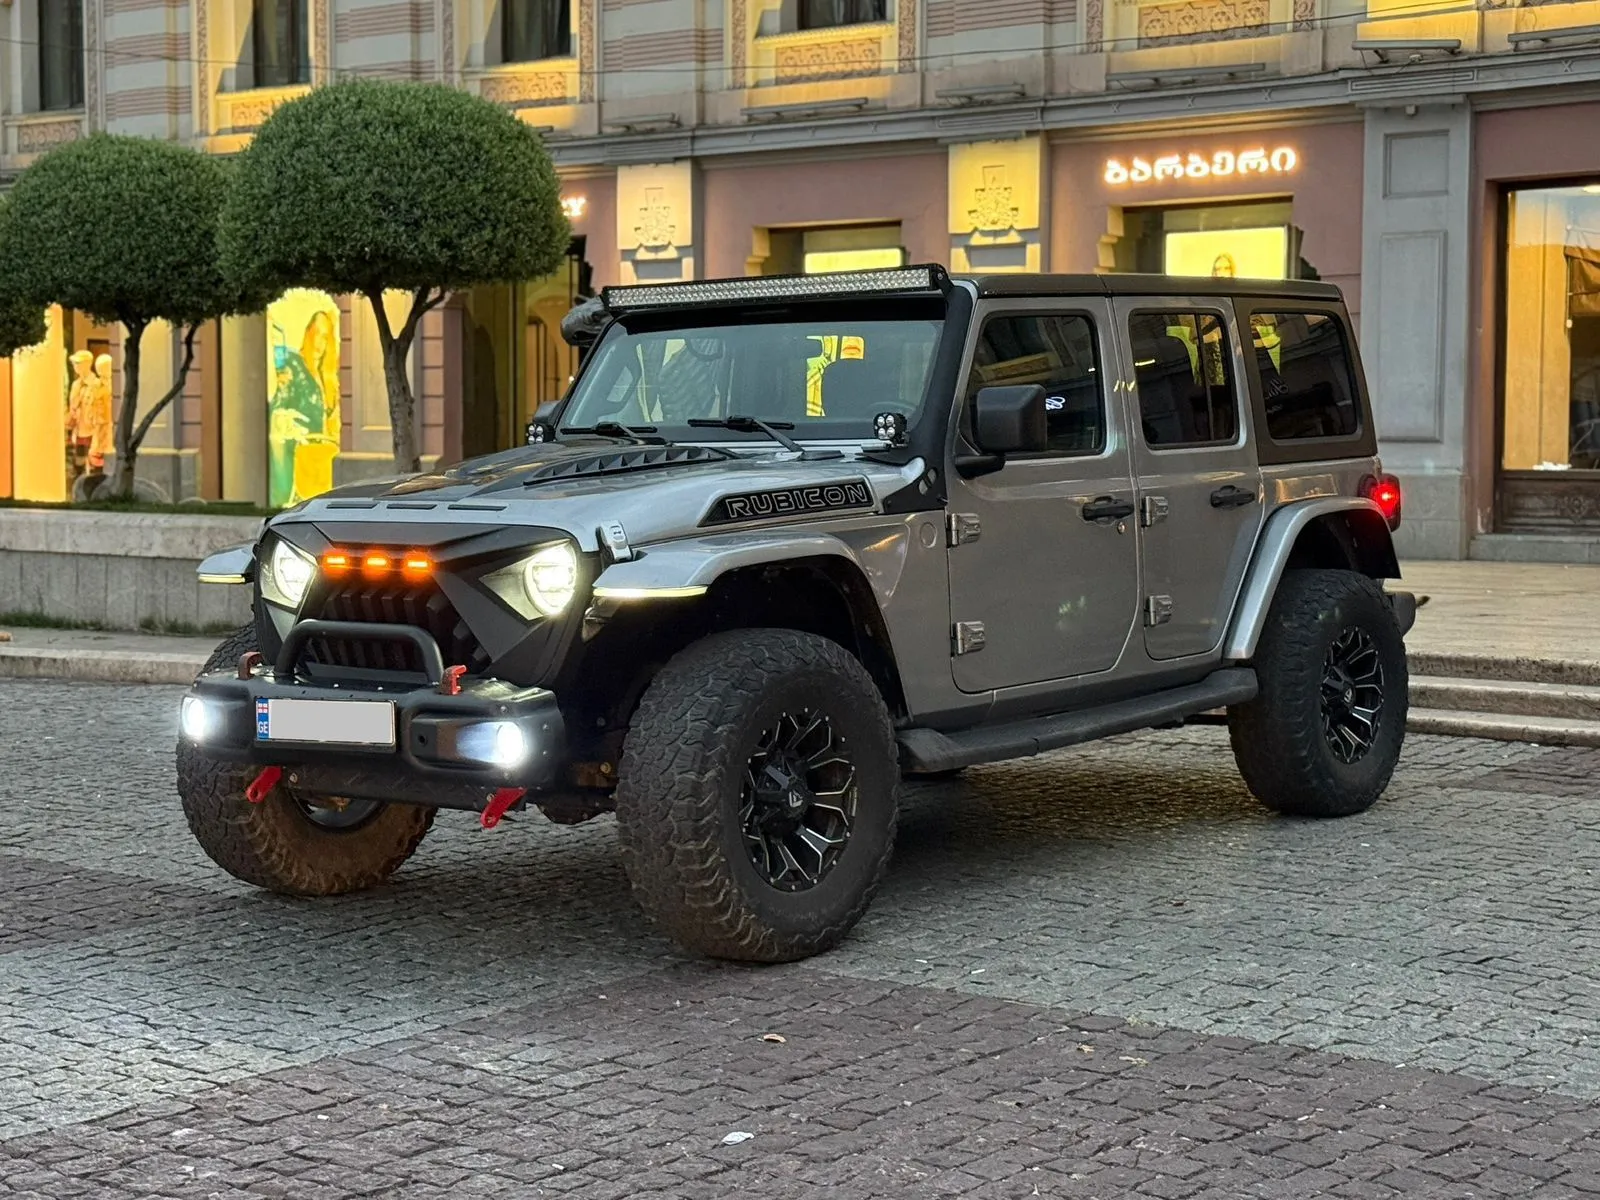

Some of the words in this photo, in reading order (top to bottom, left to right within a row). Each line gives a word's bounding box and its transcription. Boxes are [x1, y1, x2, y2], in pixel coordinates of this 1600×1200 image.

[1103, 147, 1297, 185] ბარბერი
[725, 484, 868, 518] RUBICON
[258, 721, 269, 733] GE
